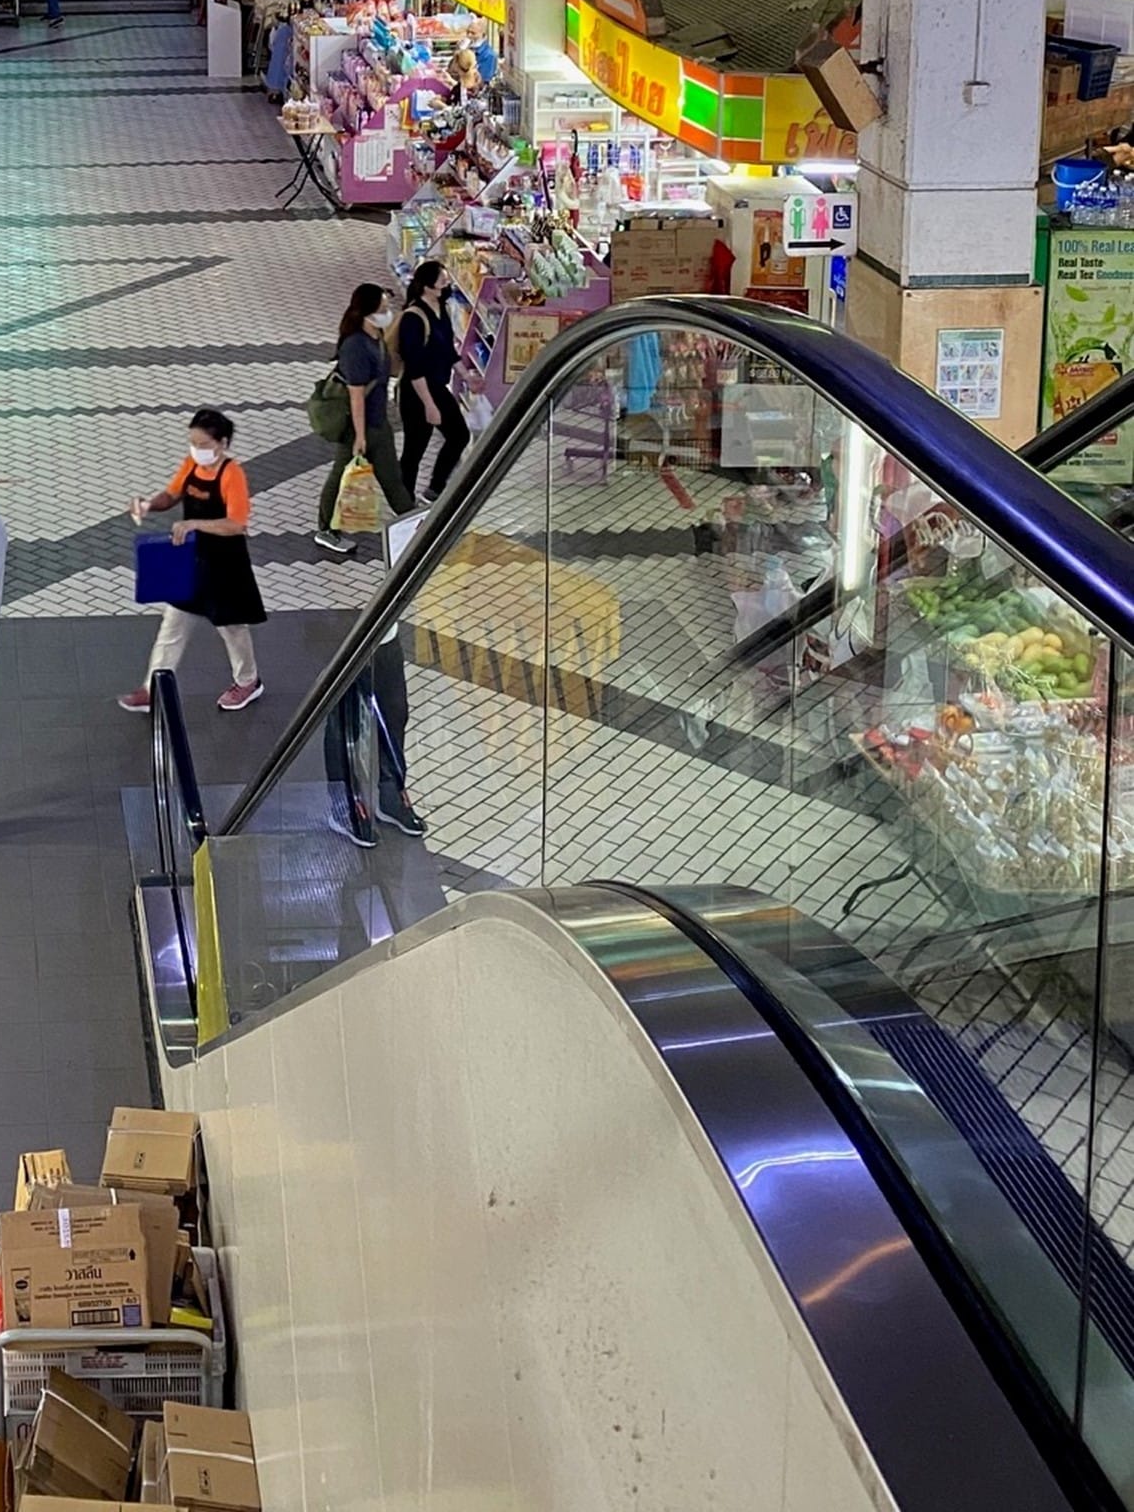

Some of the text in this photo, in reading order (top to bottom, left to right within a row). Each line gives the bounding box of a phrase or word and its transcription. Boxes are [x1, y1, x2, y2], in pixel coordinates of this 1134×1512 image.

[1091, 239, 1115, 253] Real
[1058, 257, 1105, 268] Real Taste
[1057, 269, 1077, 280] Real
[1080, 269, 1094, 280] Tea
